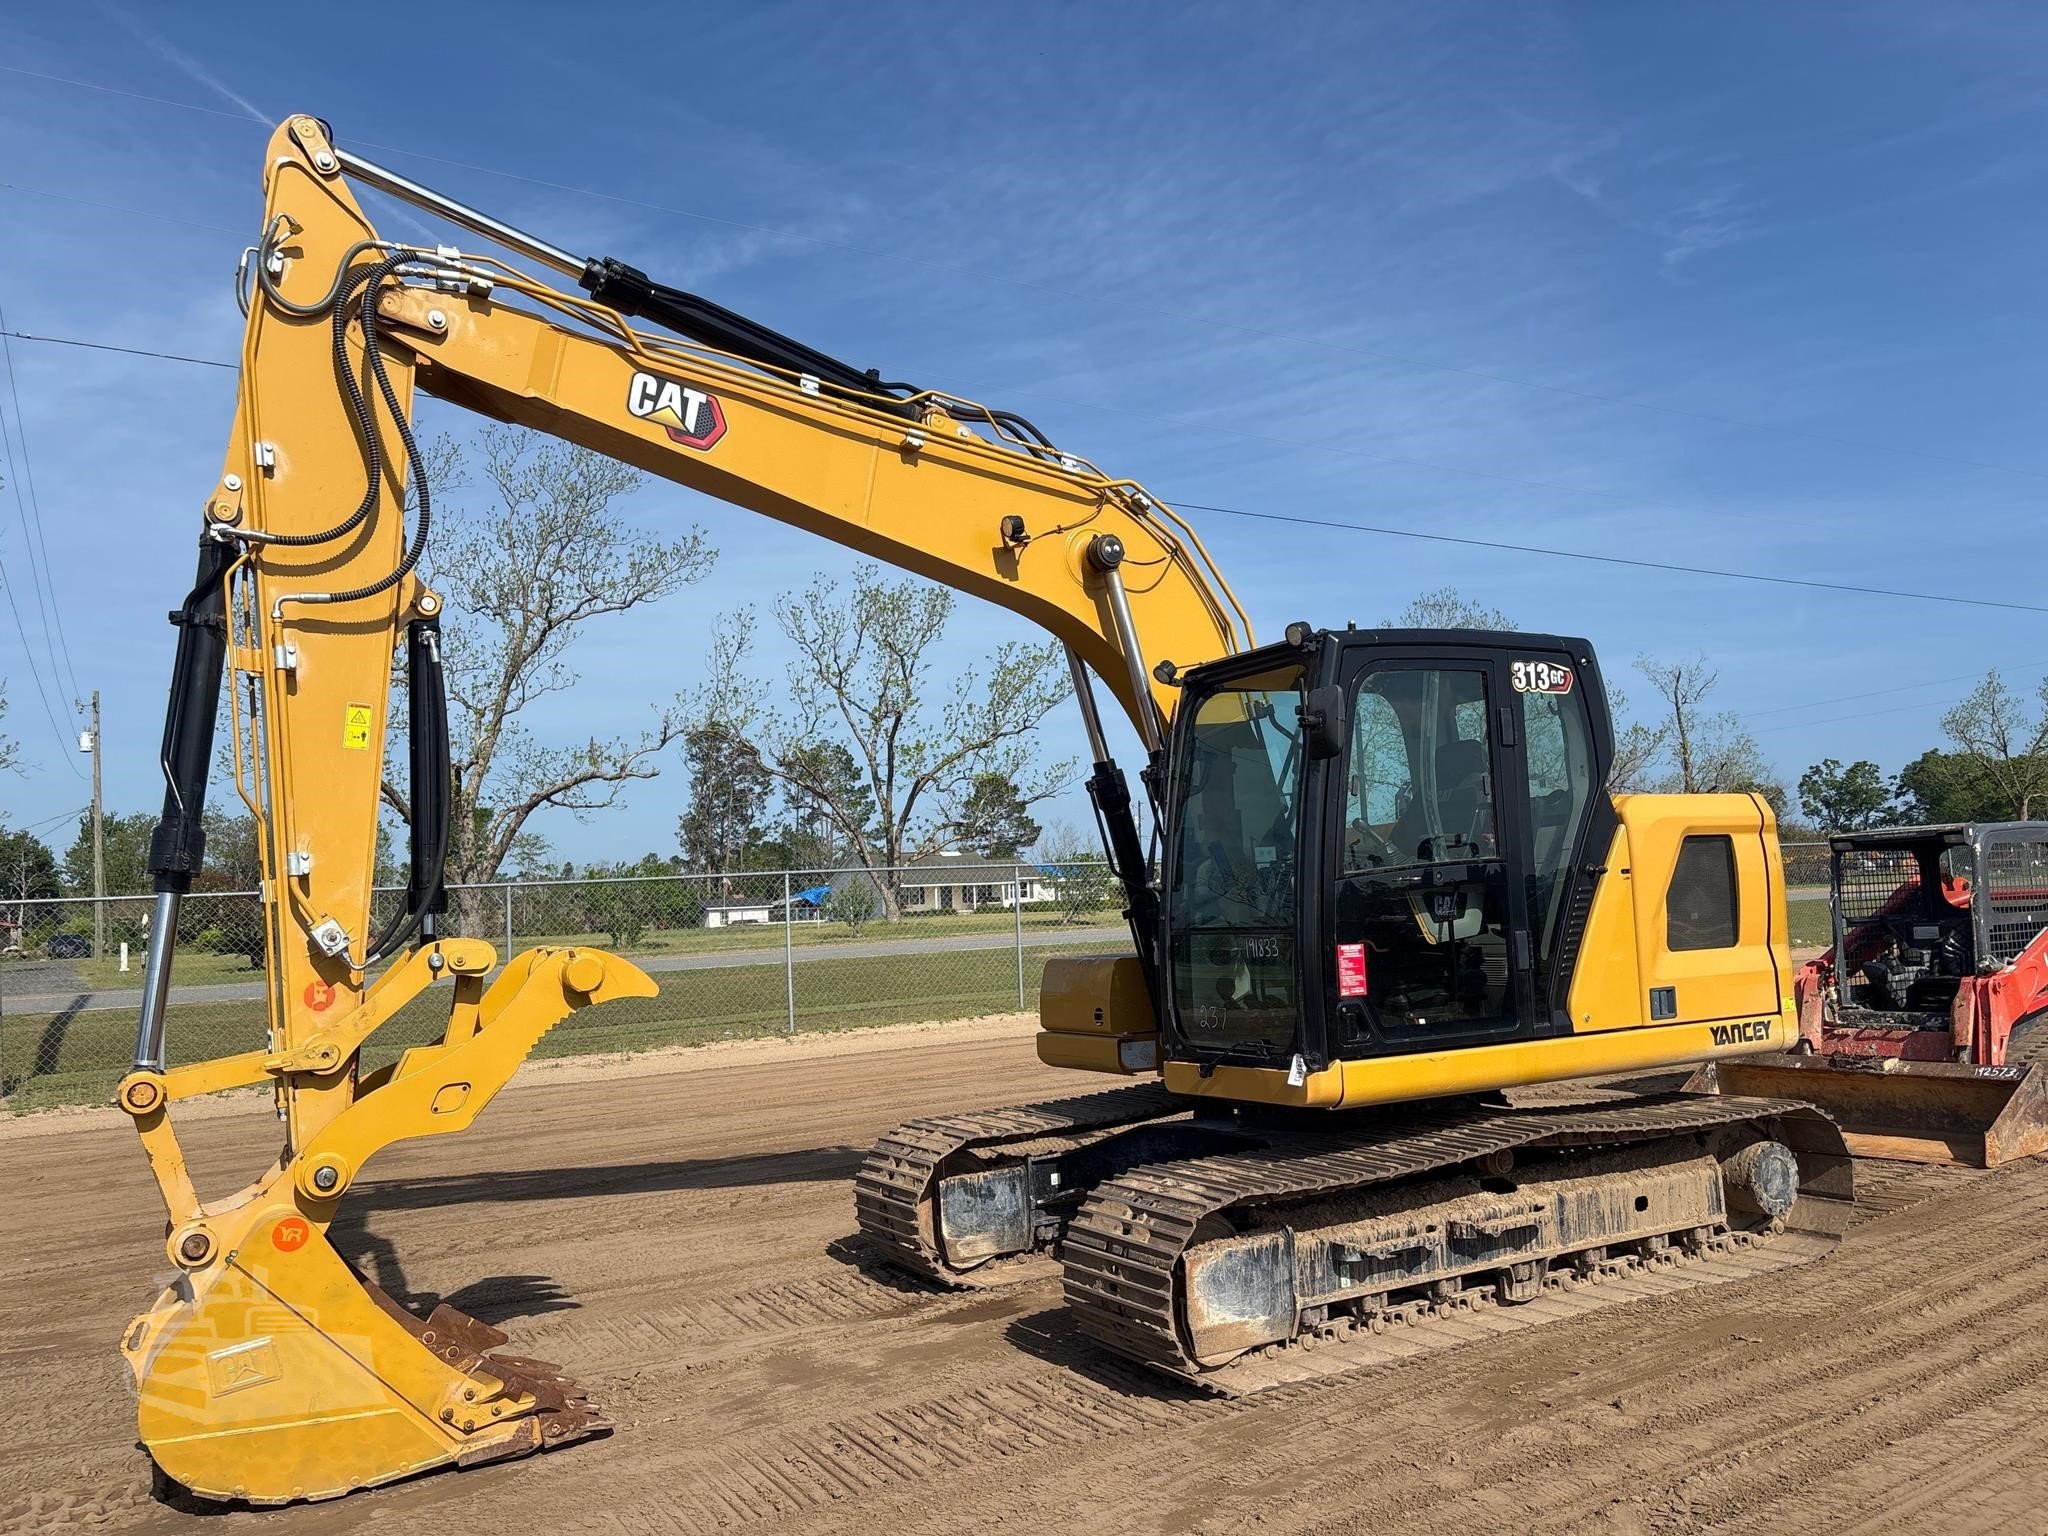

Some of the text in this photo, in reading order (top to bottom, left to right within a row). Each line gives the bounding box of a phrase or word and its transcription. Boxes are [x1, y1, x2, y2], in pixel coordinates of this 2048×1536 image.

[628, 371, 708, 434] CAT
[1513, 662, 1565, 690] 313 GC
[1246, 937, 1279, 959] 191833
[1200, 1004, 1227, 1030] 237
[1709, 1020, 1772, 1046] YANCEY
[216, 1348, 273, 1387] CAT
